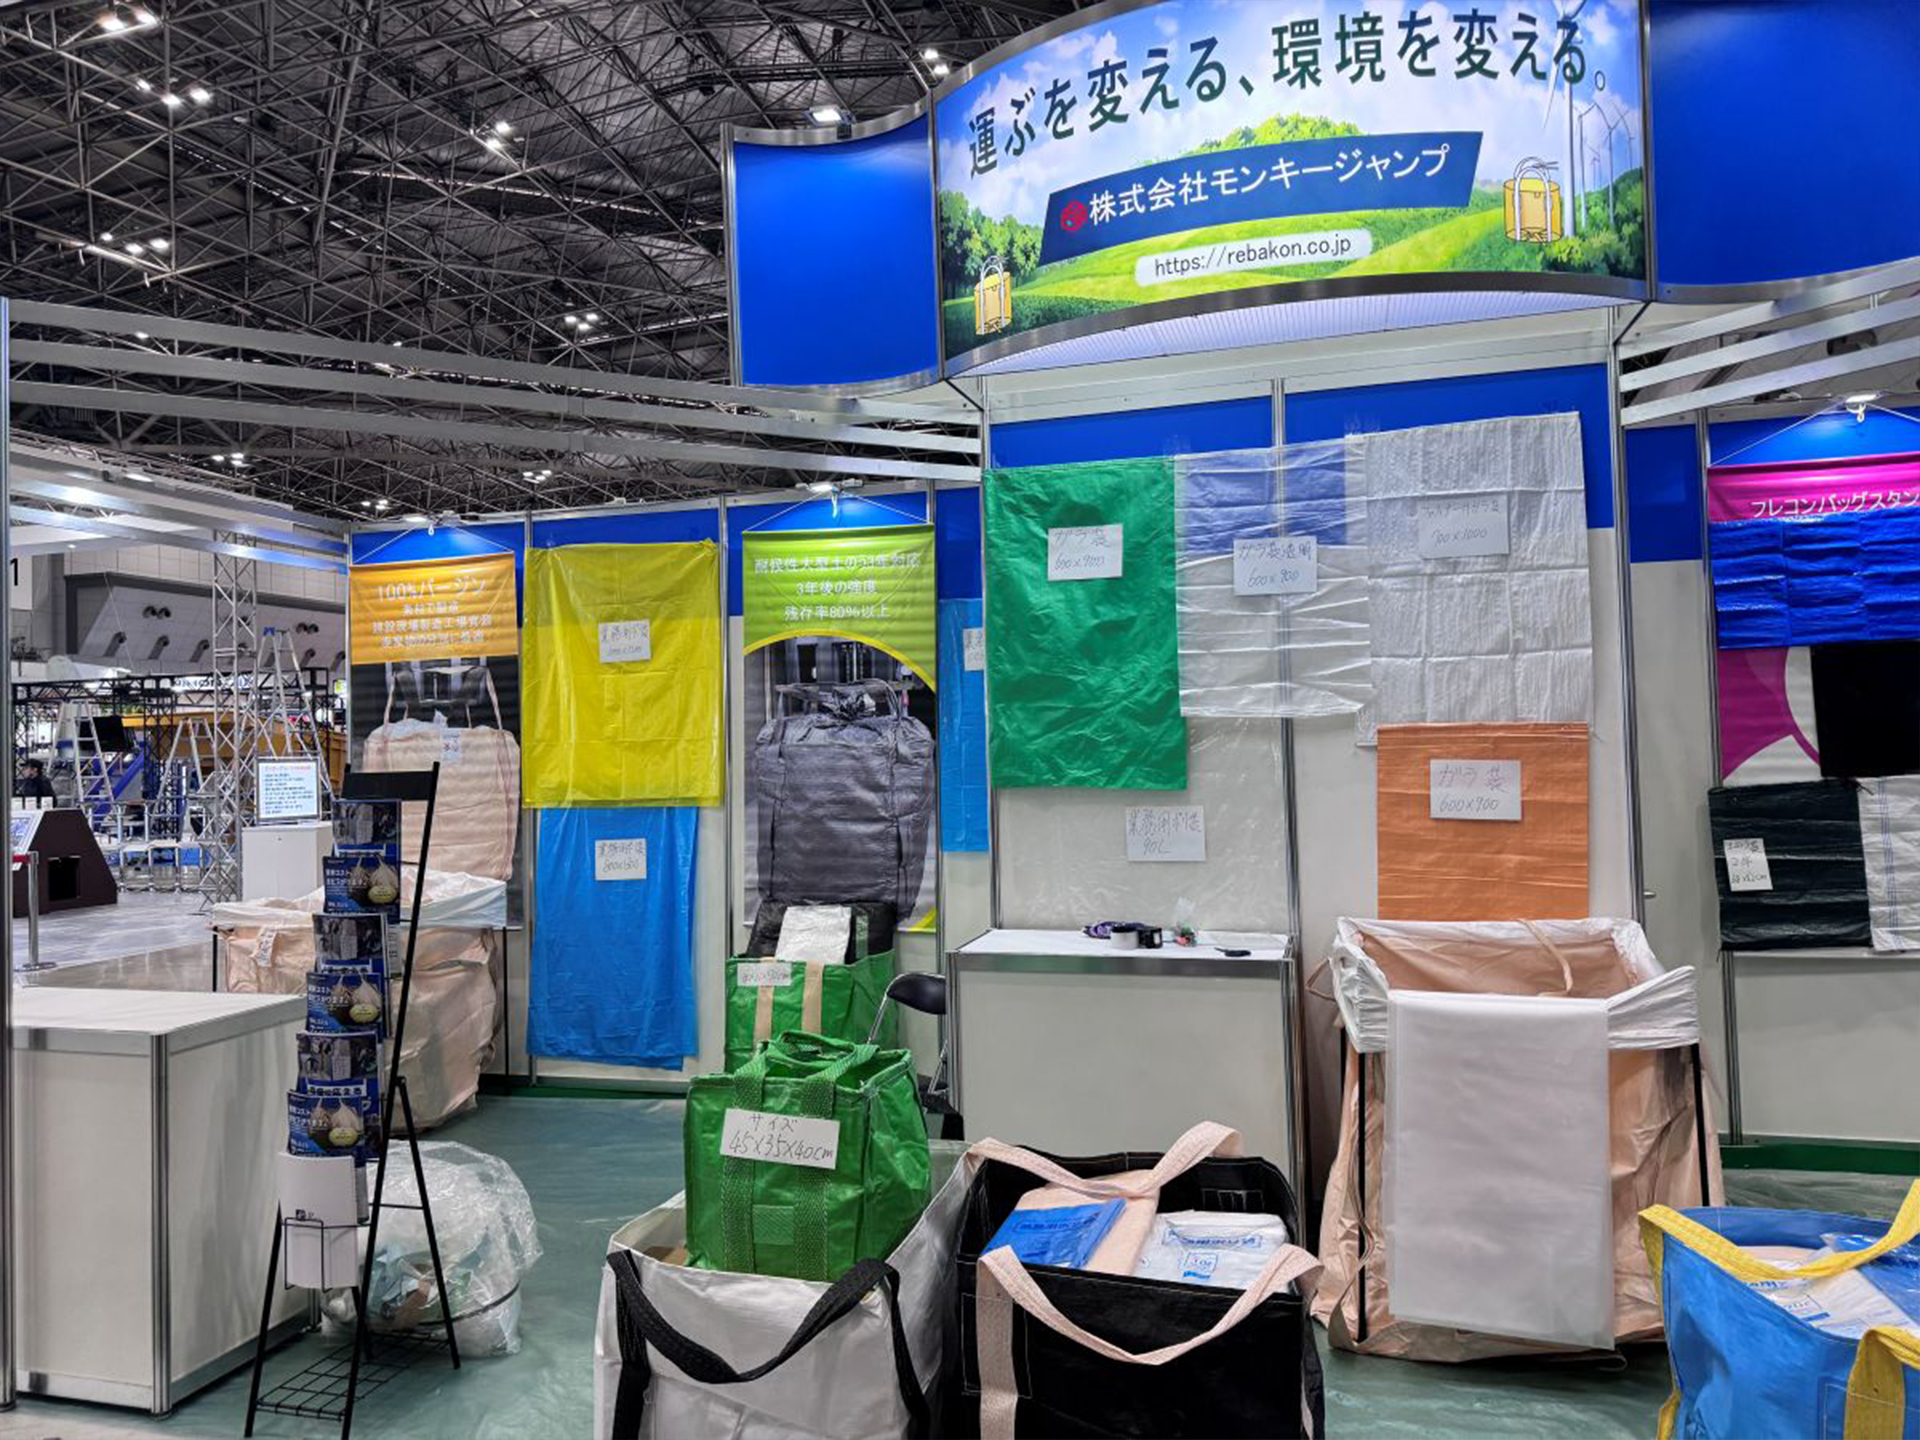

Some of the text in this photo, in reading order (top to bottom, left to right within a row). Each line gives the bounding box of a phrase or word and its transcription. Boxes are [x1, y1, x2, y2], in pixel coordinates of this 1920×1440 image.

[970, 9, 1606, 180] 運ぶを変える、環境を変える。
[1088, 143, 1450, 226] 株式会社モンキージャンプ
[1155, 237, 1351, 277] https://rebakon.co.jp
[750, 1113, 798, 1132] サイズ
